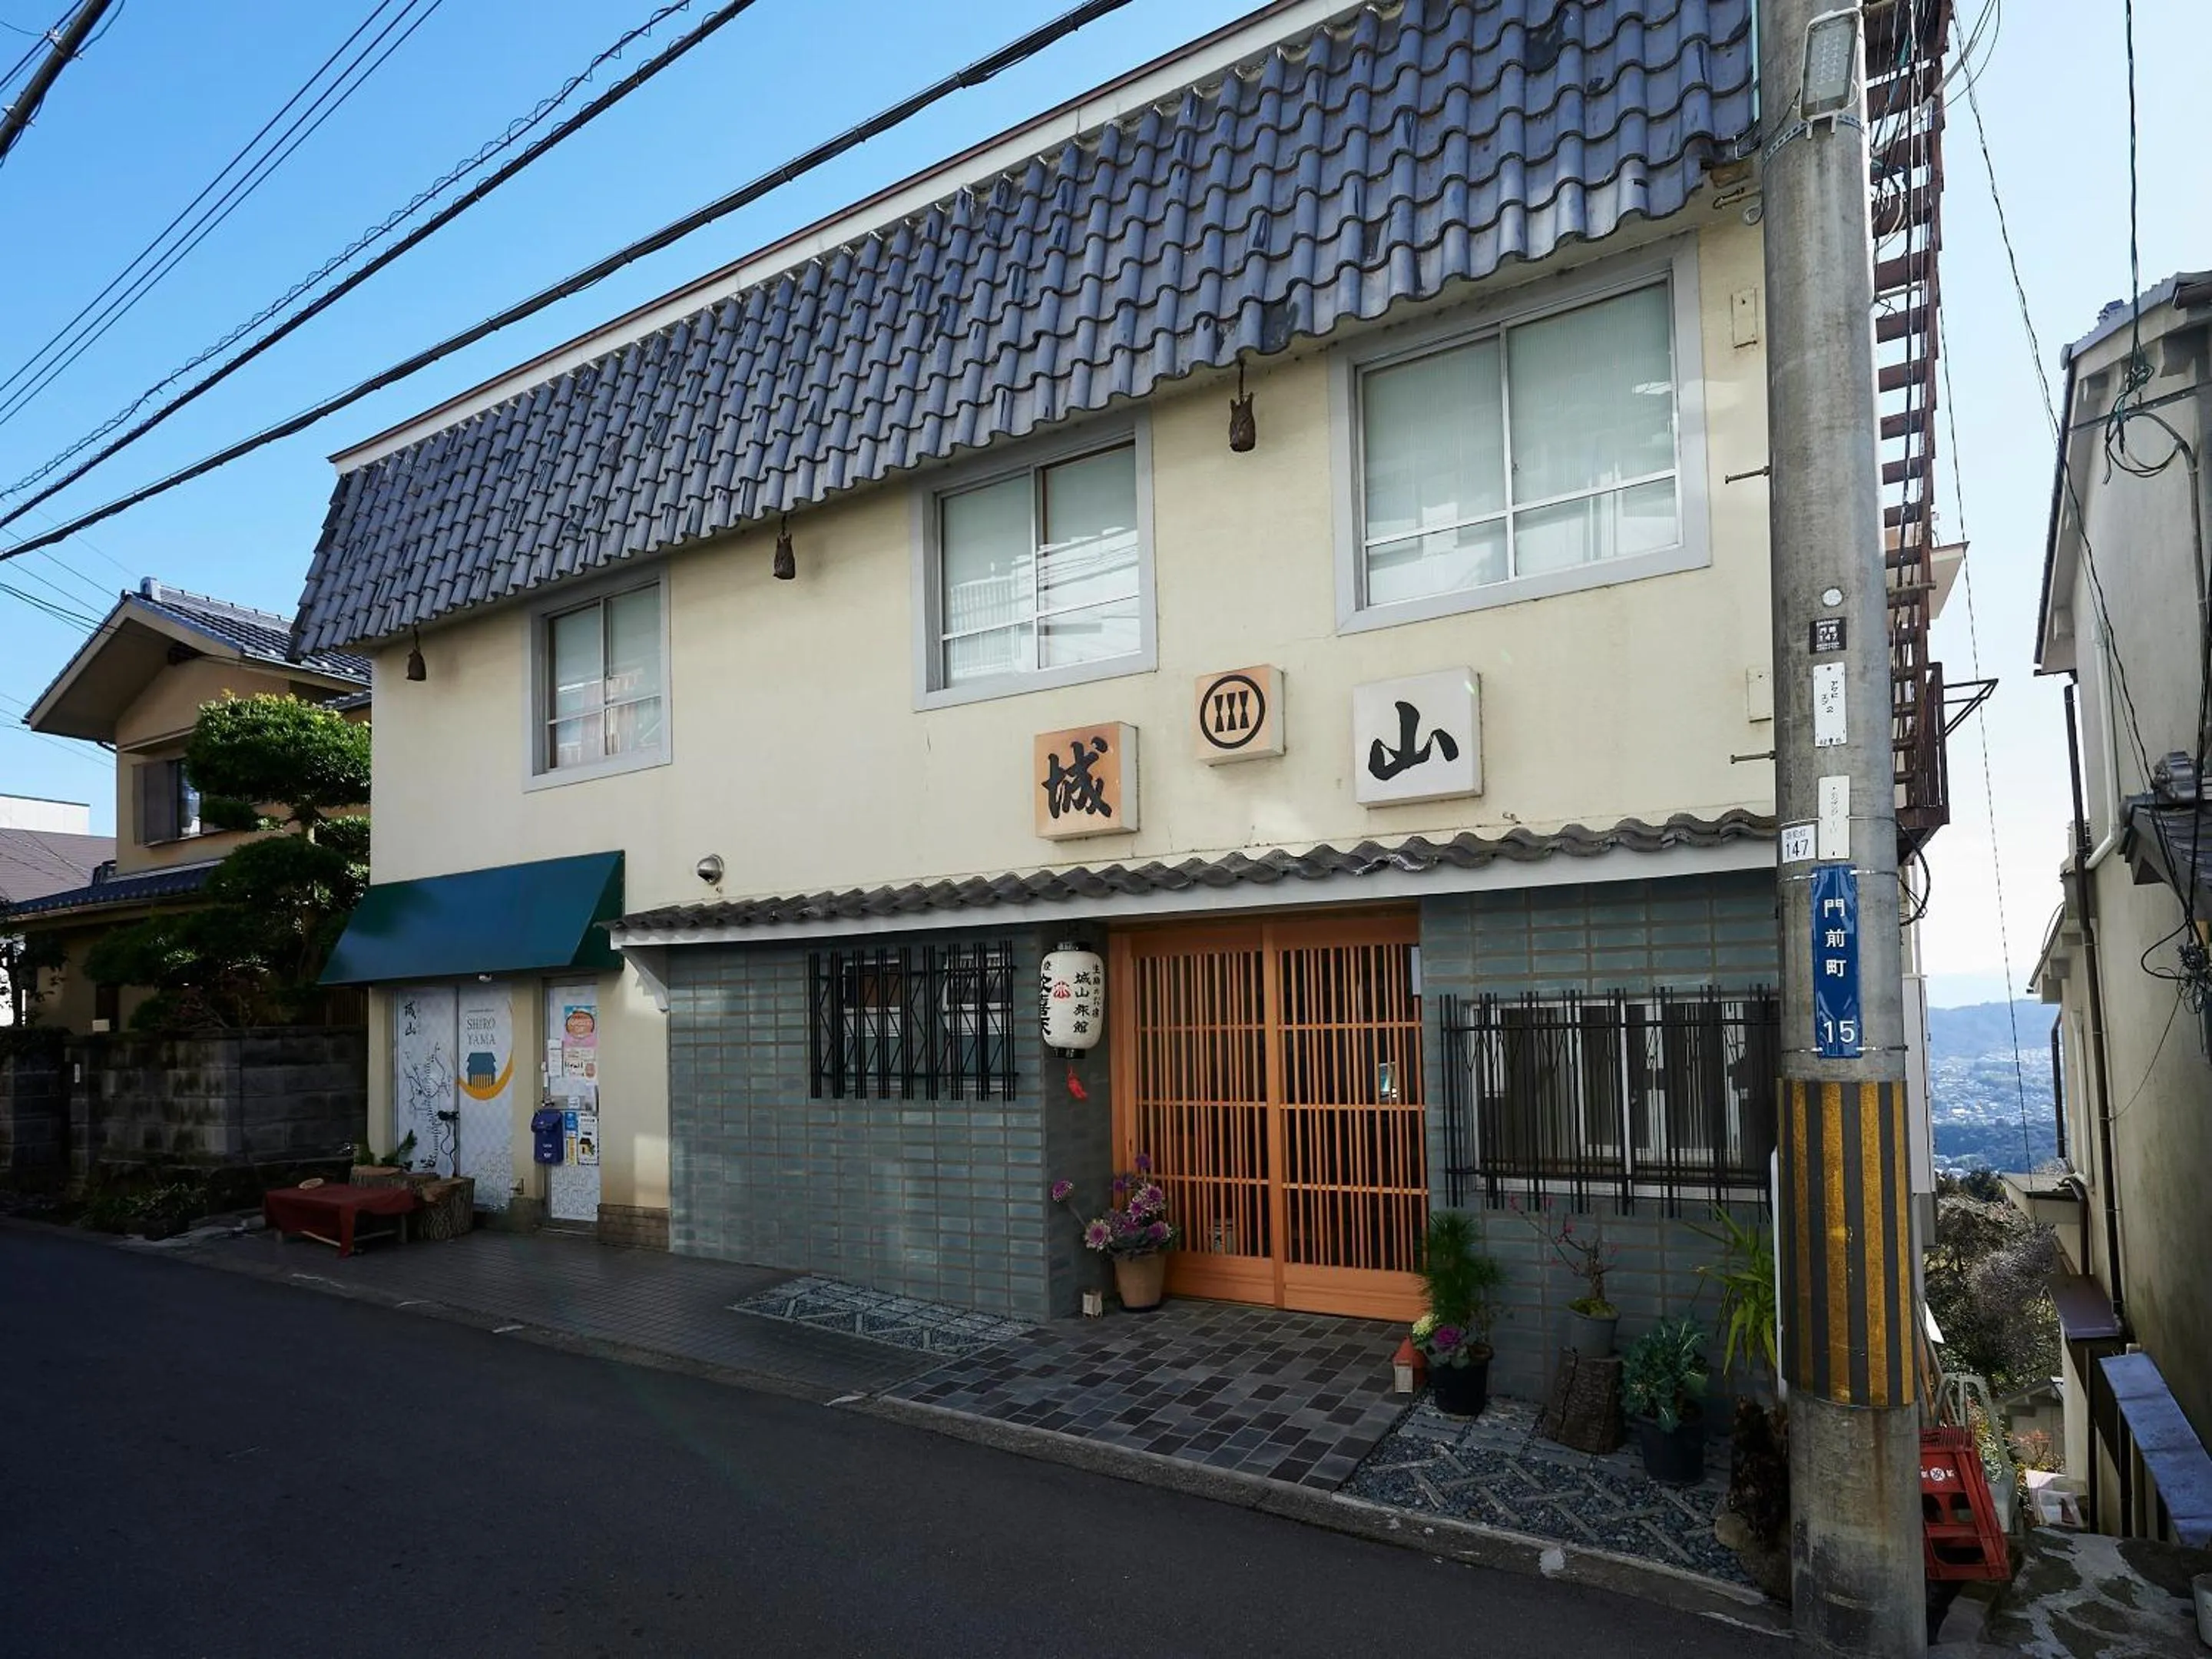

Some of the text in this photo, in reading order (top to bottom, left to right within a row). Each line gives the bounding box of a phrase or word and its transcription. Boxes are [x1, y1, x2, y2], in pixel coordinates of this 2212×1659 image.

[1041, 700, 1460, 820] 城 山
[1786, 839, 1809, 858] 147
[1823, 898, 1846, 978] 門前町
[1073, 971, 1091, 1033] 城山旅館
[467, 1016, 496, 1030] SHIRO
[1823, 1019, 1856, 1044] 15
[467, 1033, 496, 1045] YAMA
